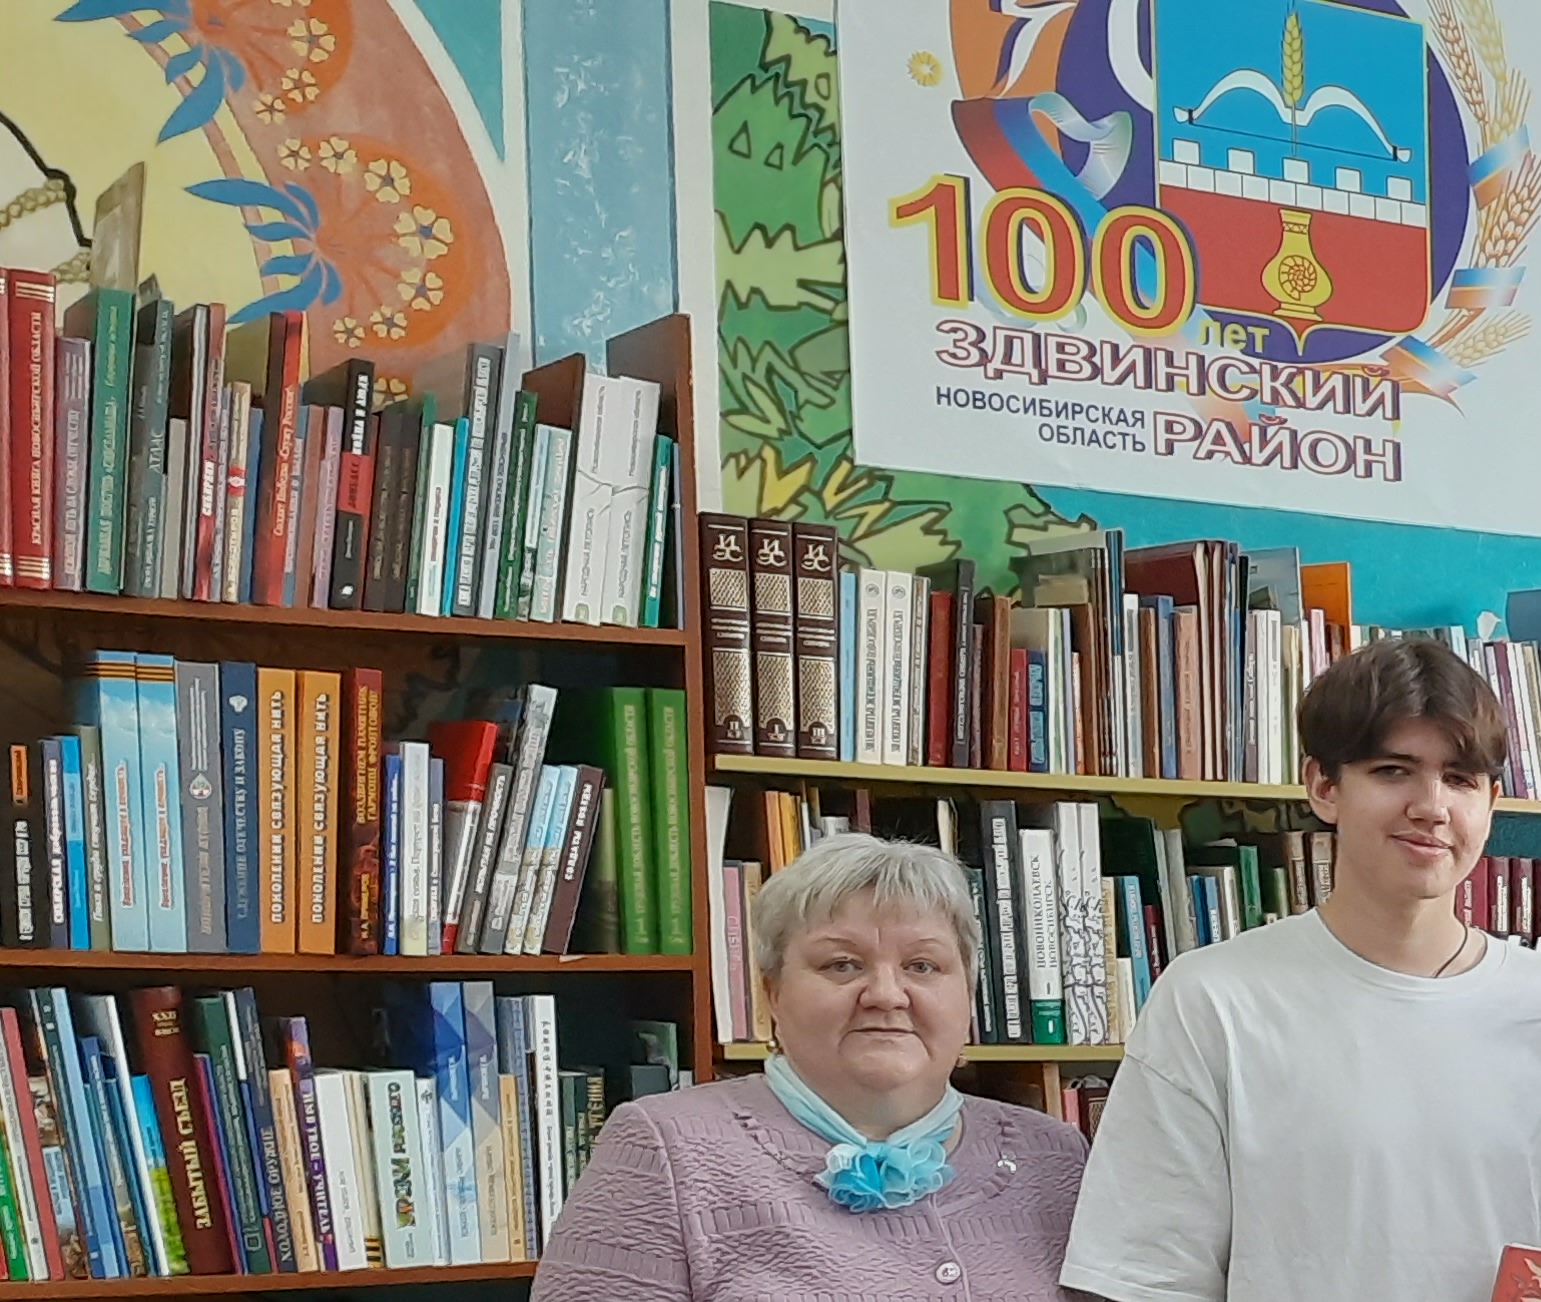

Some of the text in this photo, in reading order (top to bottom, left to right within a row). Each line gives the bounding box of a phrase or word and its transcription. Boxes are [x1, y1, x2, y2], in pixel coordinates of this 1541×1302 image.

[888, 173, 1197, 338] 100
[30, 312, 42, 362] ОБЛАСТИ
[1198, 317, 1269, 355] лет
[934, 317, 1402, 422] ЗДВИНСКИЙ
[935, 385, 1147, 431] НОВОСИБИРСКАЯ
[1037, 420, 1147, 455] ОБЛАСТЬ
[1152, 408, 1402, 482] РАЙОН
[31, 460, 42, 495] КНИГА
[31, 497, 42, 545] КРАСНАЯ
[271, 691, 283, 729] НИТЬ
[314, 694, 327, 731] НИТЬ
[234, 728, 246, 773] ЗАКОНУ
[270, 734, 284, 829] СВЯЗУЮЩАЯ
[312, 736, 328, 830] СВЯЗУЮЩАЯ
[564, 830, 582, 880] СОЛДАТЫ
[1030, 855, 1046, 968] НОВОНИКОЛАЕВСК
[169, 1078, 212, 1230] ЗАБЫТЫЙ СЪЕЗД
[260, 1126, 292, 1262] ХОЛОДНОЕ ОРУЖИЕ
[312, 1174, 330, 1233] УЧИТЕЛЬ
